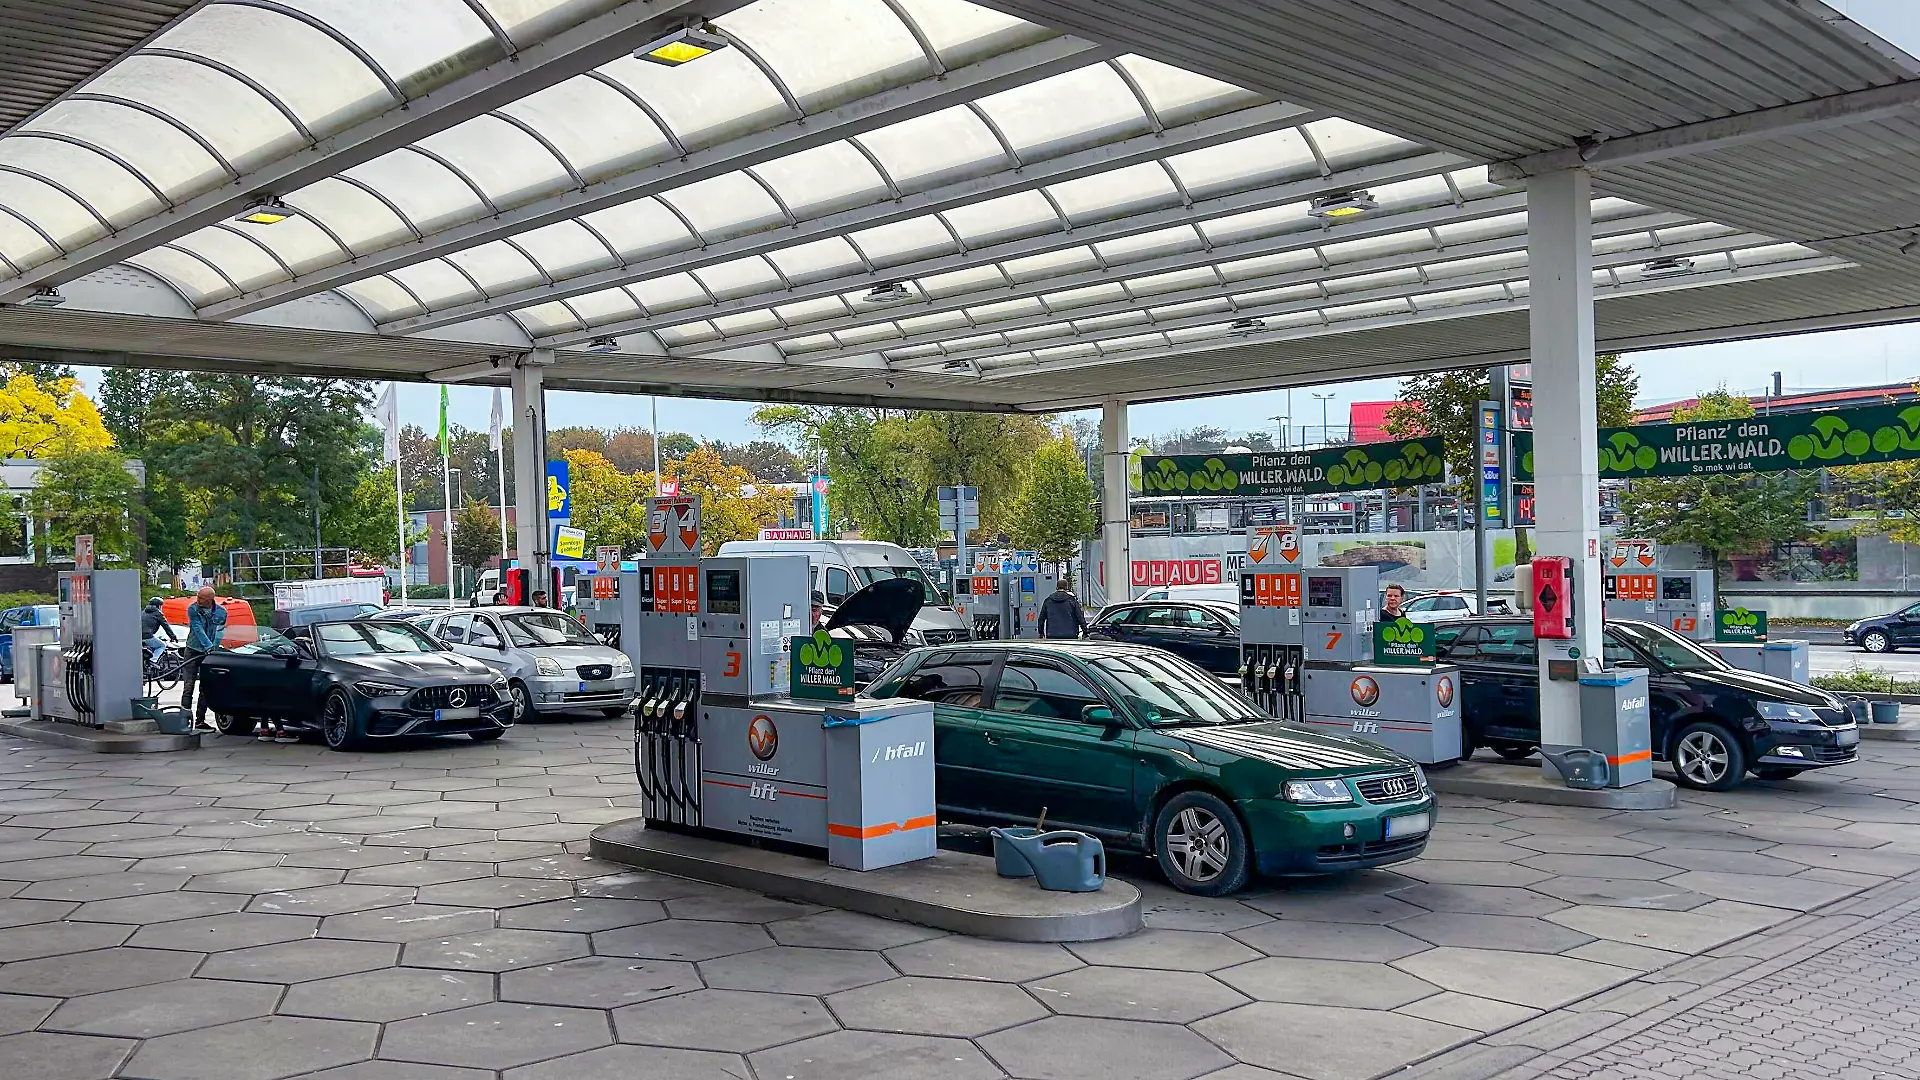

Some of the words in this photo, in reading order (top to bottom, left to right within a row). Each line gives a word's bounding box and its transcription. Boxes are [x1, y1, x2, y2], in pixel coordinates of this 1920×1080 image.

[1738, 423, 1768, 437] den
[1660, 439, 1785, 463] WILLER.WALD.
[1290, 454, 1311, 466] den
[1240, 467, 1325, 484] WILLER.WALD.
[651, 510, 667, 533] 3
[678, 508, 696, 532] 4
[765, 530, 811, 540] BAUHAUS
[1252, 535, 1267, 551] 7
[1280, 533, 1297, 550] 8
[611, 552, 618, 562] 6
[1634, 546, 1655, 558] 14
[1131, 561, 1220, 585] UHAUS
[1673, 618, 1696, 631] 13
[1325, 632, 1343, 650] 7
[723, 652, 741, 677] 3
[800, 674, 842, 685] WILLER.WALD.
[1621, 697, 1645, 711] Abfall
[1350, 708, 1380, 717] willer
[1352, 721, 1379, 734] bft
[748, 763, 779, 776] willer
[749, 781, 778, 801] bft
